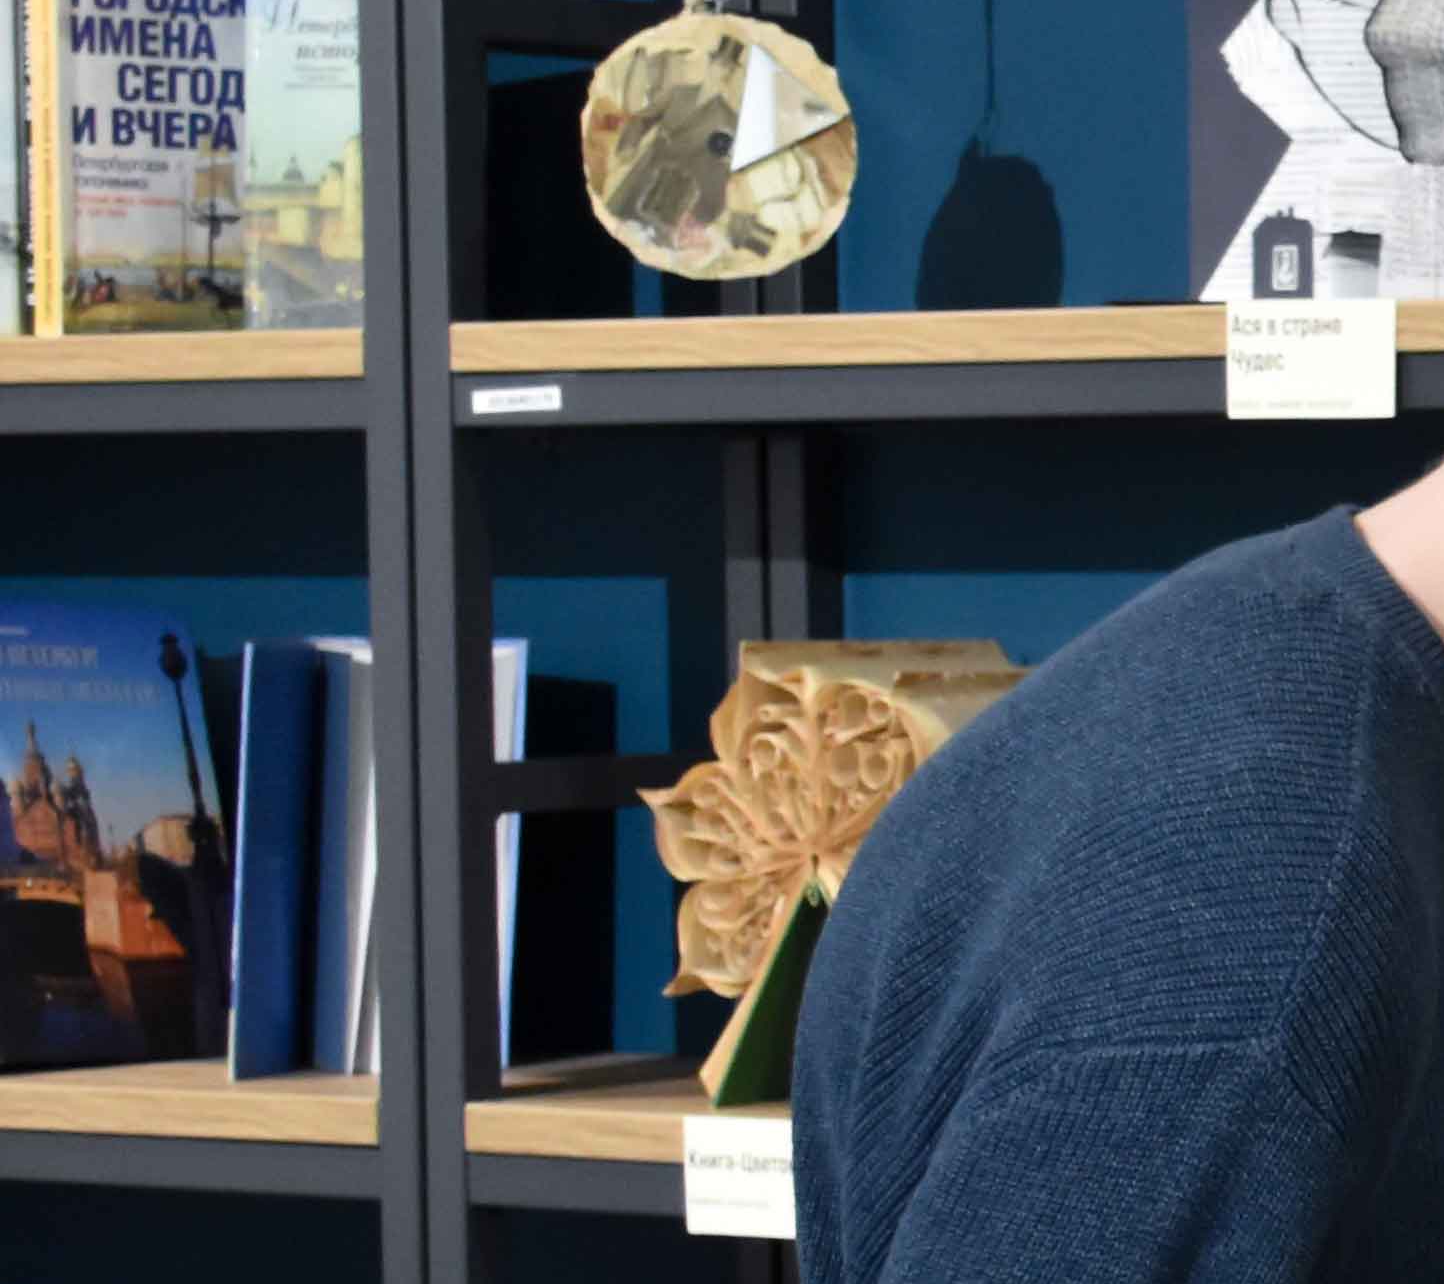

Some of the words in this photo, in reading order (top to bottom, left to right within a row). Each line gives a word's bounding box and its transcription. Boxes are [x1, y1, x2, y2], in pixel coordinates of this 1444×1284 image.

[71, 15, 216, 60] ИМЕНА
[71, 106, 96, 144] И
[111, 109, 238, 151] ВЧЕРА
[1231, 351, 1286, 374] Чудес
